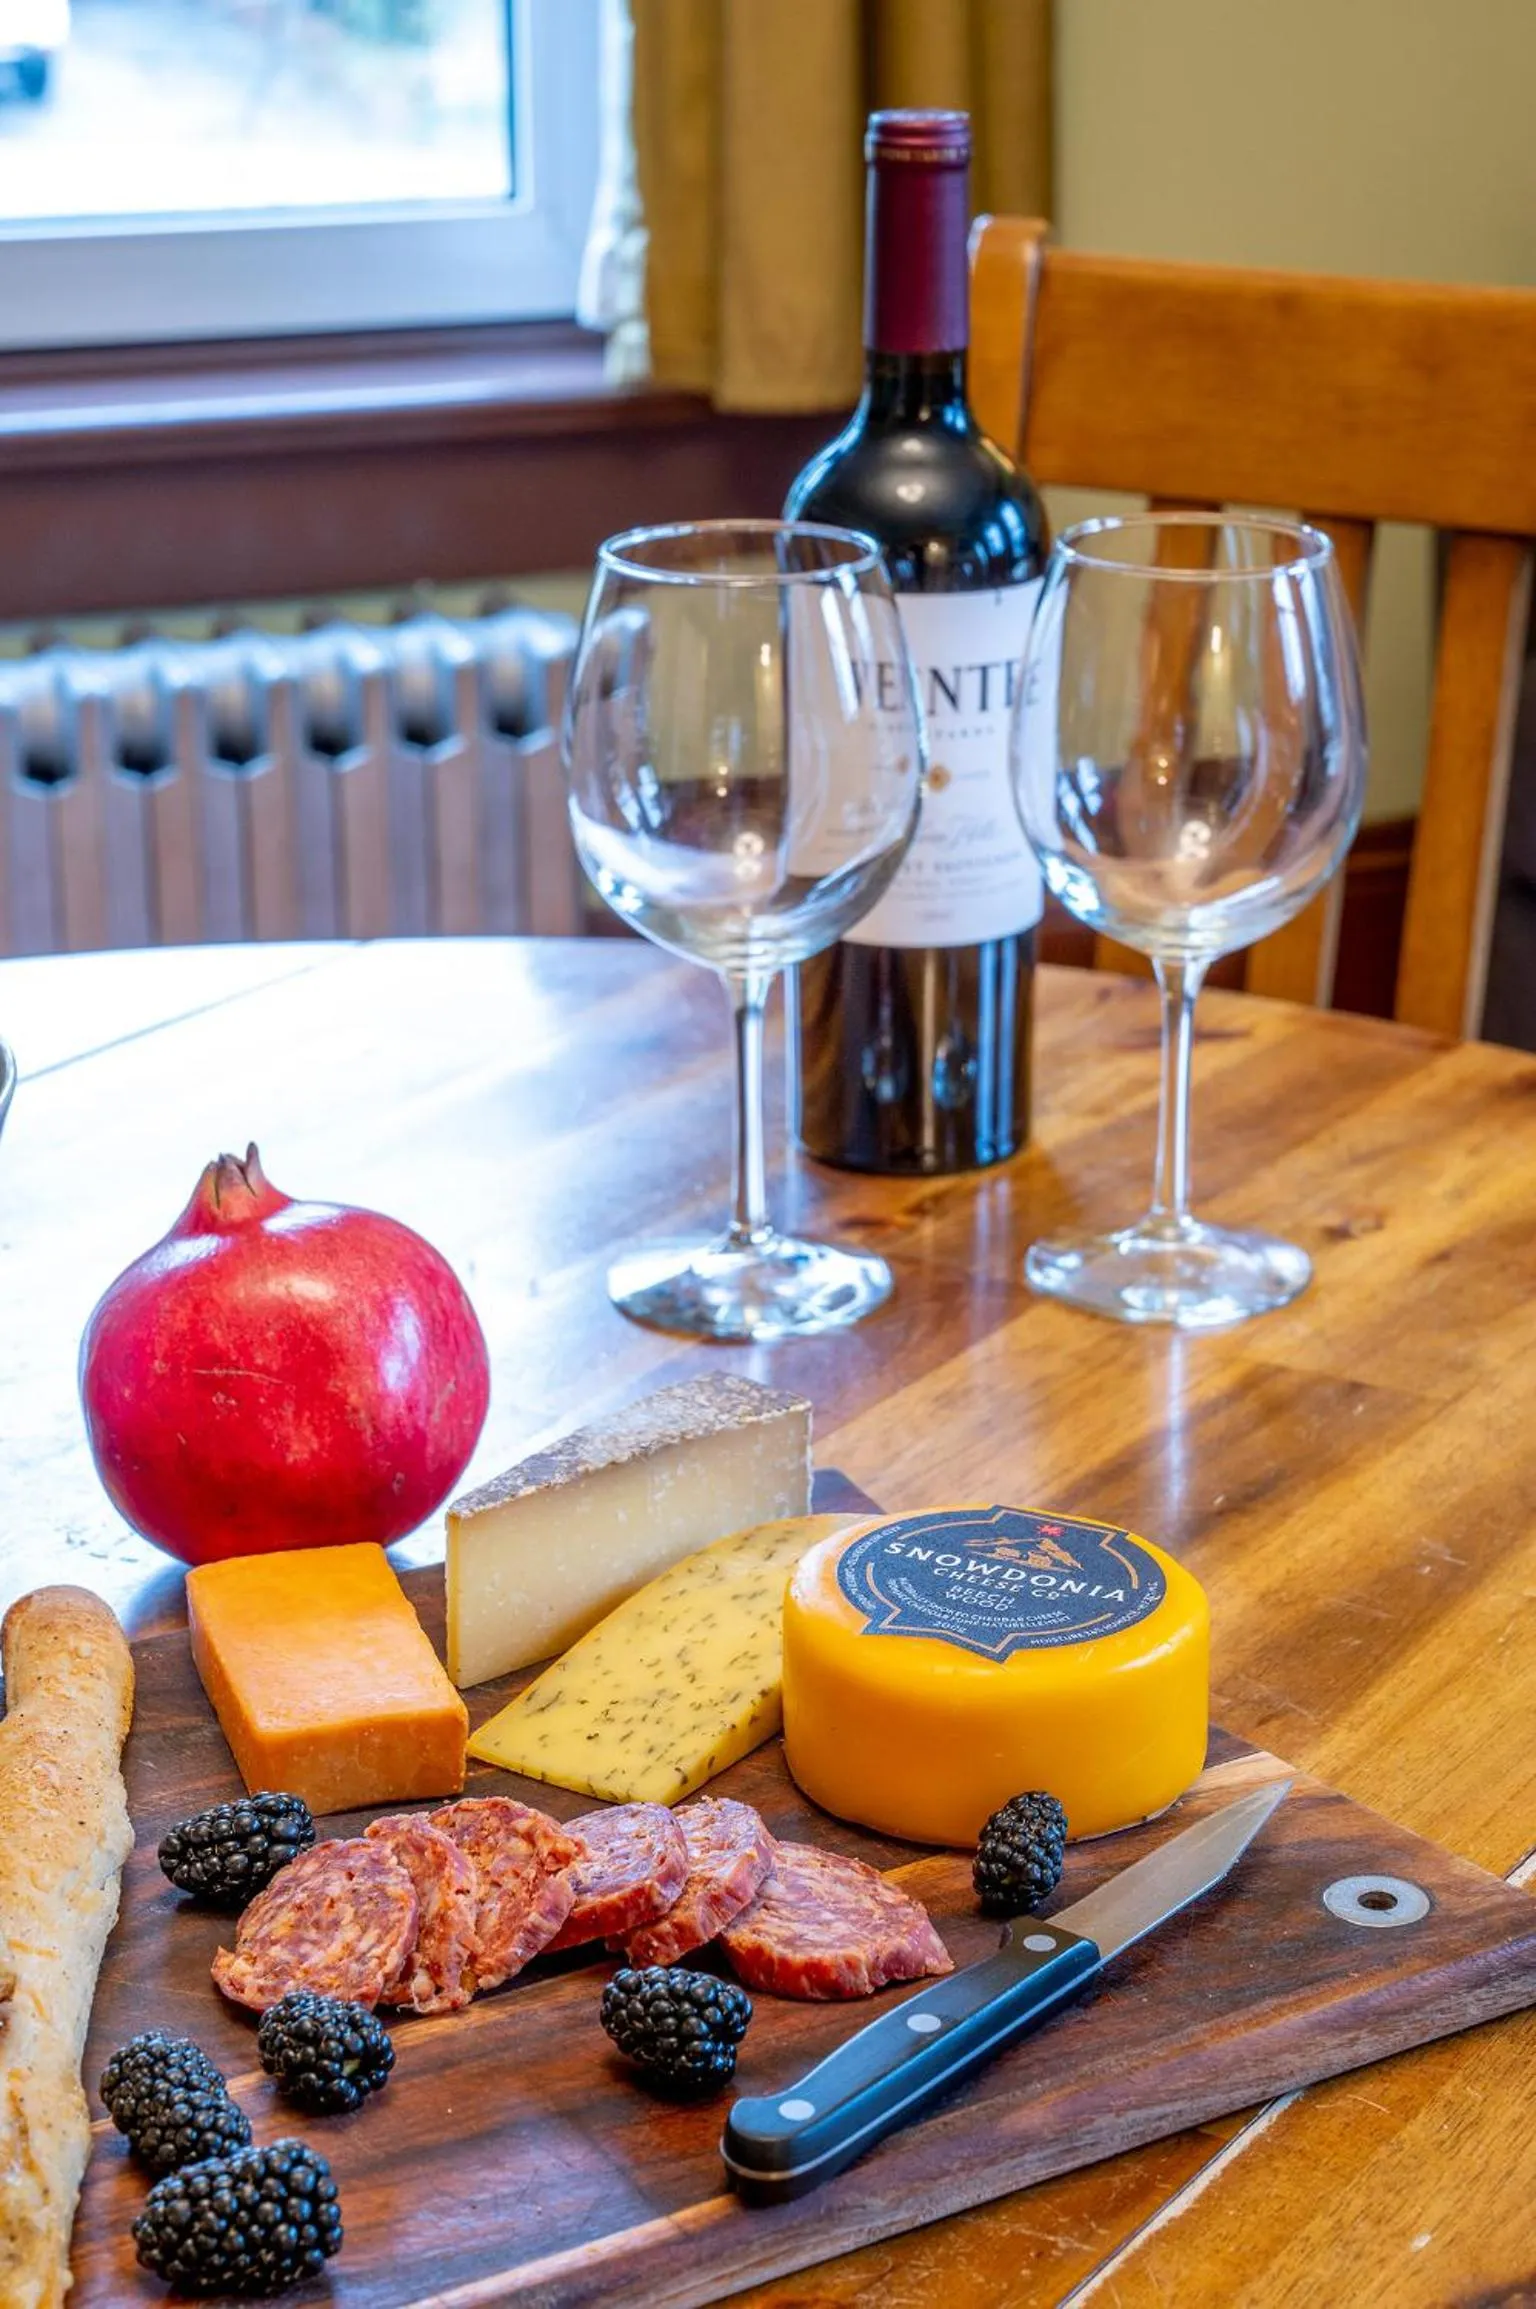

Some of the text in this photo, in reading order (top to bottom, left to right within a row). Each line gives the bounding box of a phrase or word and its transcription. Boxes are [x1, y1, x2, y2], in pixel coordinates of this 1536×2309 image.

[884, 1541, 1125, 1602] SNOWDONIA
[933, 1567, 1024, 1593] CHEESE
[945, 1591, 1010, 1612] WOOD
[950, 1585, 1016, 1604] BEECH
